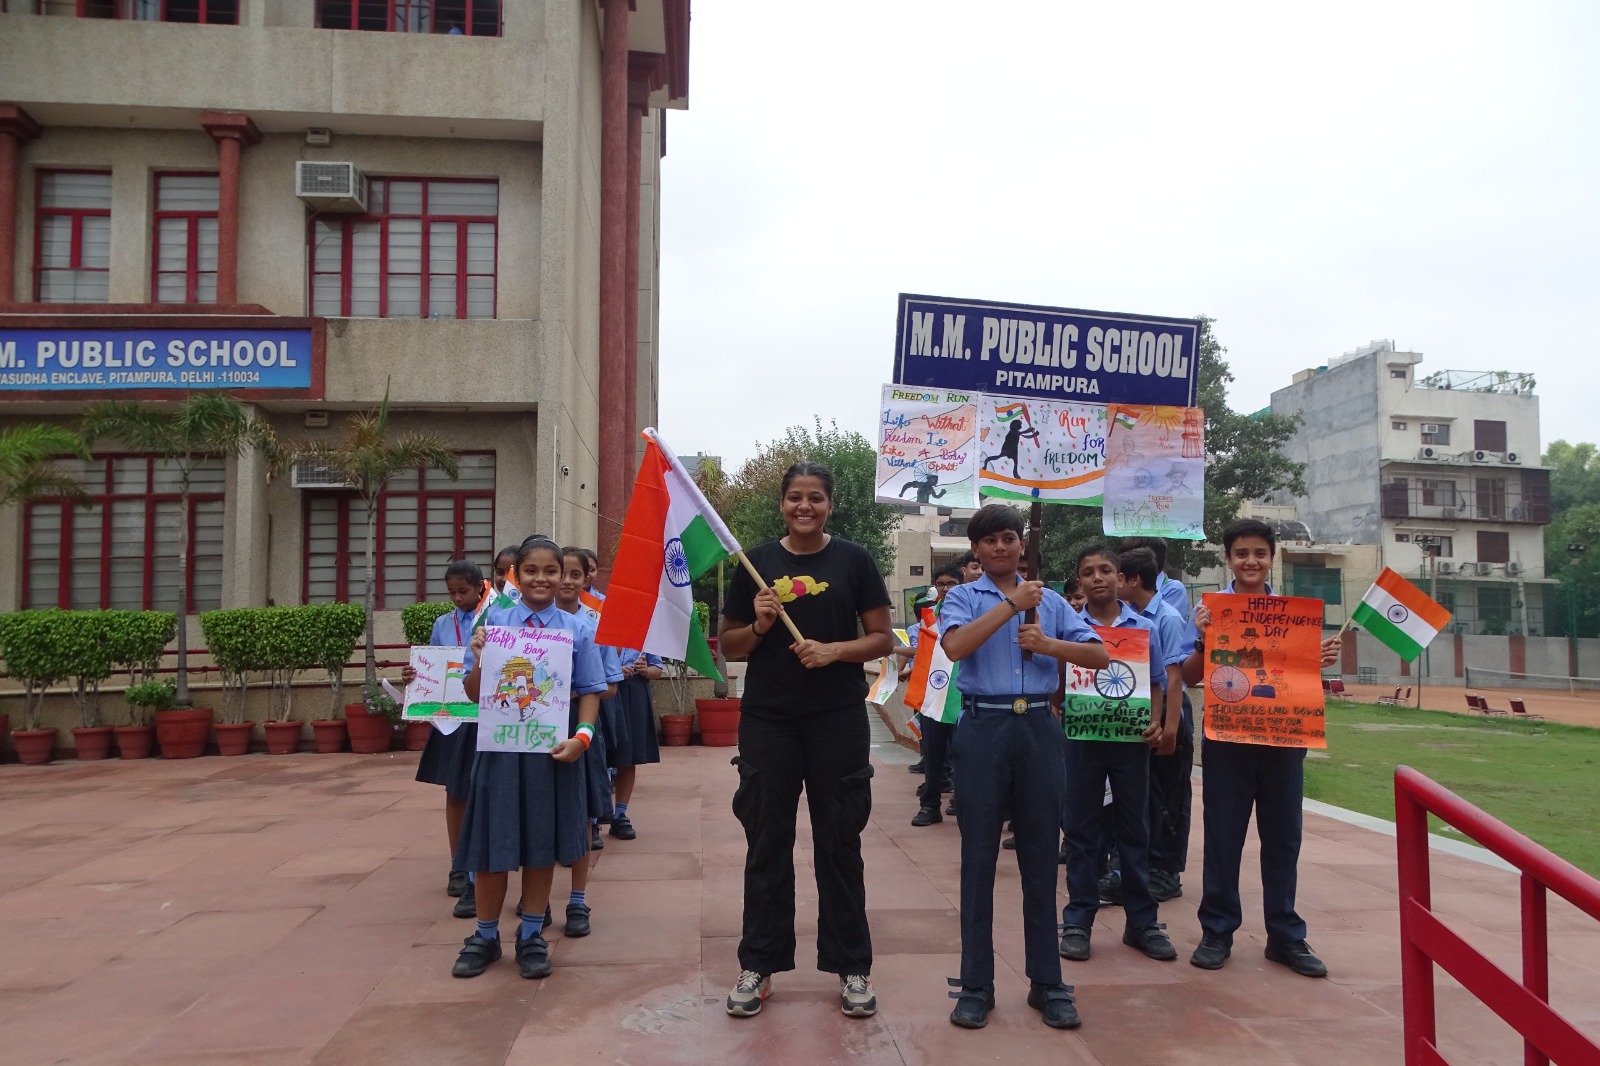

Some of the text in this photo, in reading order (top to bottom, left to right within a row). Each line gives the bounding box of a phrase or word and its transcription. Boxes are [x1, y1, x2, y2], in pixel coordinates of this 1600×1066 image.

[36, 340, 156, 368] PUBLIC
[166, 339, 297, 367] SCHOOL
[909, 311, 1189, 379] M.M. PUBLIC SCHOOL
[0, 372, 48, 385] ASUDHA
[51, 371, 106, 386] ENCLAVE,
[109, 371, 178, 385] PITAMPURA,
[180, 371, 215, 383] DELHI
[995, 369, 1100, 395] PITAMPURA
[945, 393, 970, 403] RUN
[1247, 597, 1289, 612] HAPPY
[1239, 610, 1322, 627] INDEPENDENCE
[486, 627, 517, 649] Happy
[1263, 624, 1289, 638] DAY
[523, 643, 549, 661] Day
[1068, 725, 1097, 737] DAY
